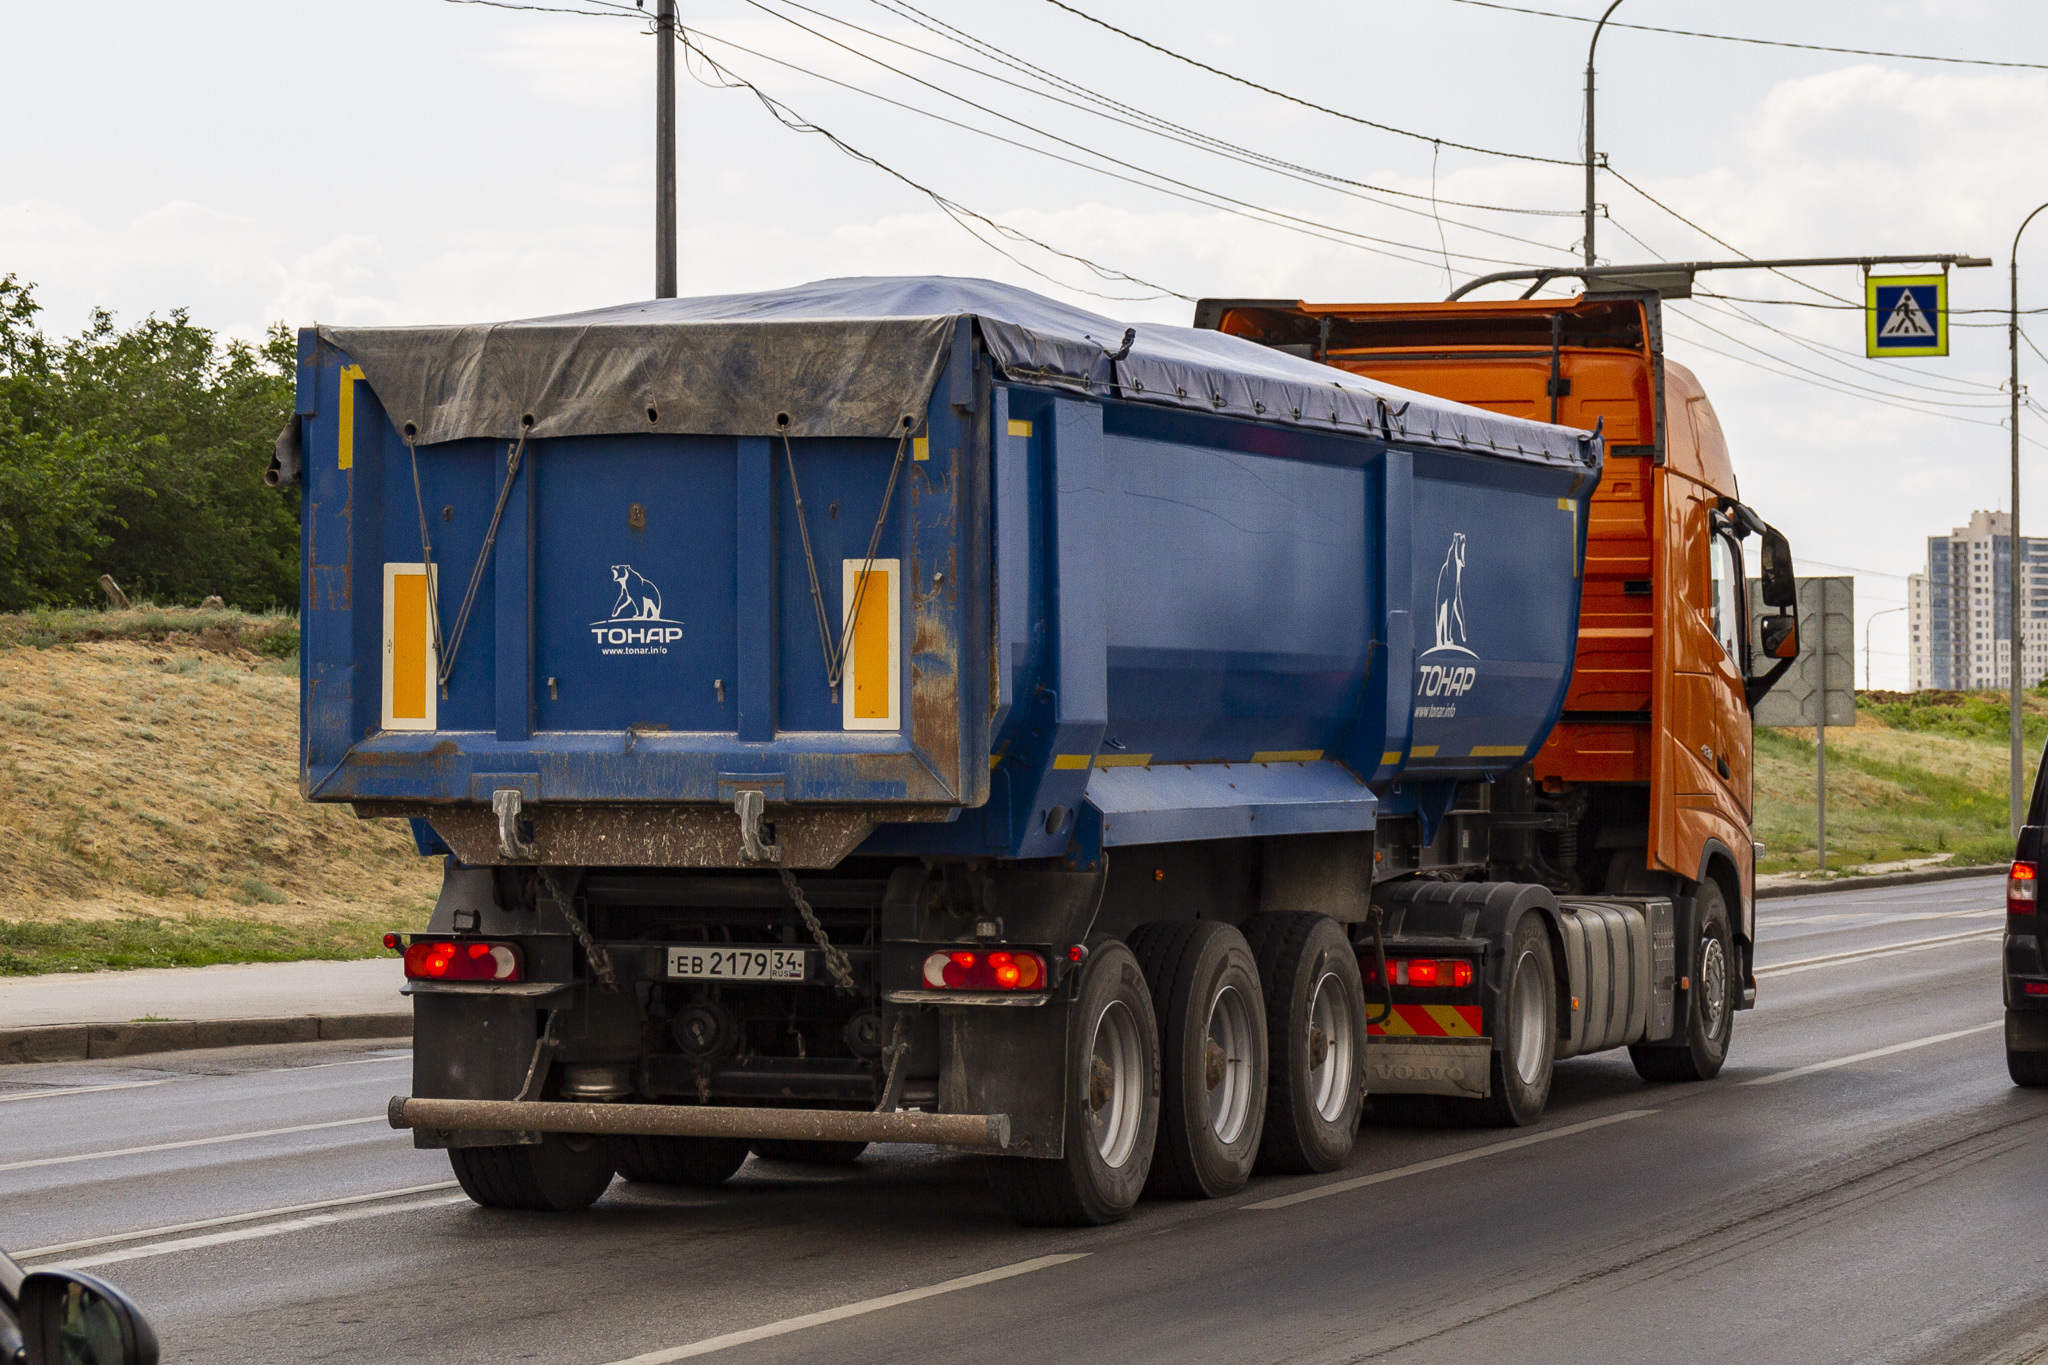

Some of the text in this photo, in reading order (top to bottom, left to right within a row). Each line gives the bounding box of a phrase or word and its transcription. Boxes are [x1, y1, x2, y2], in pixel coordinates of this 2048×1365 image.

[591, 627, 683, 644] ТОНАР
[601, 646, 668, 655] www.tonar.info
[1417, 665, 1476, 697] ТОНАР
[709, 952, 768, 976] 2179
[774, 952, 796, 970] 34
[1373, 1064, 1466, 1081] VOLVO
